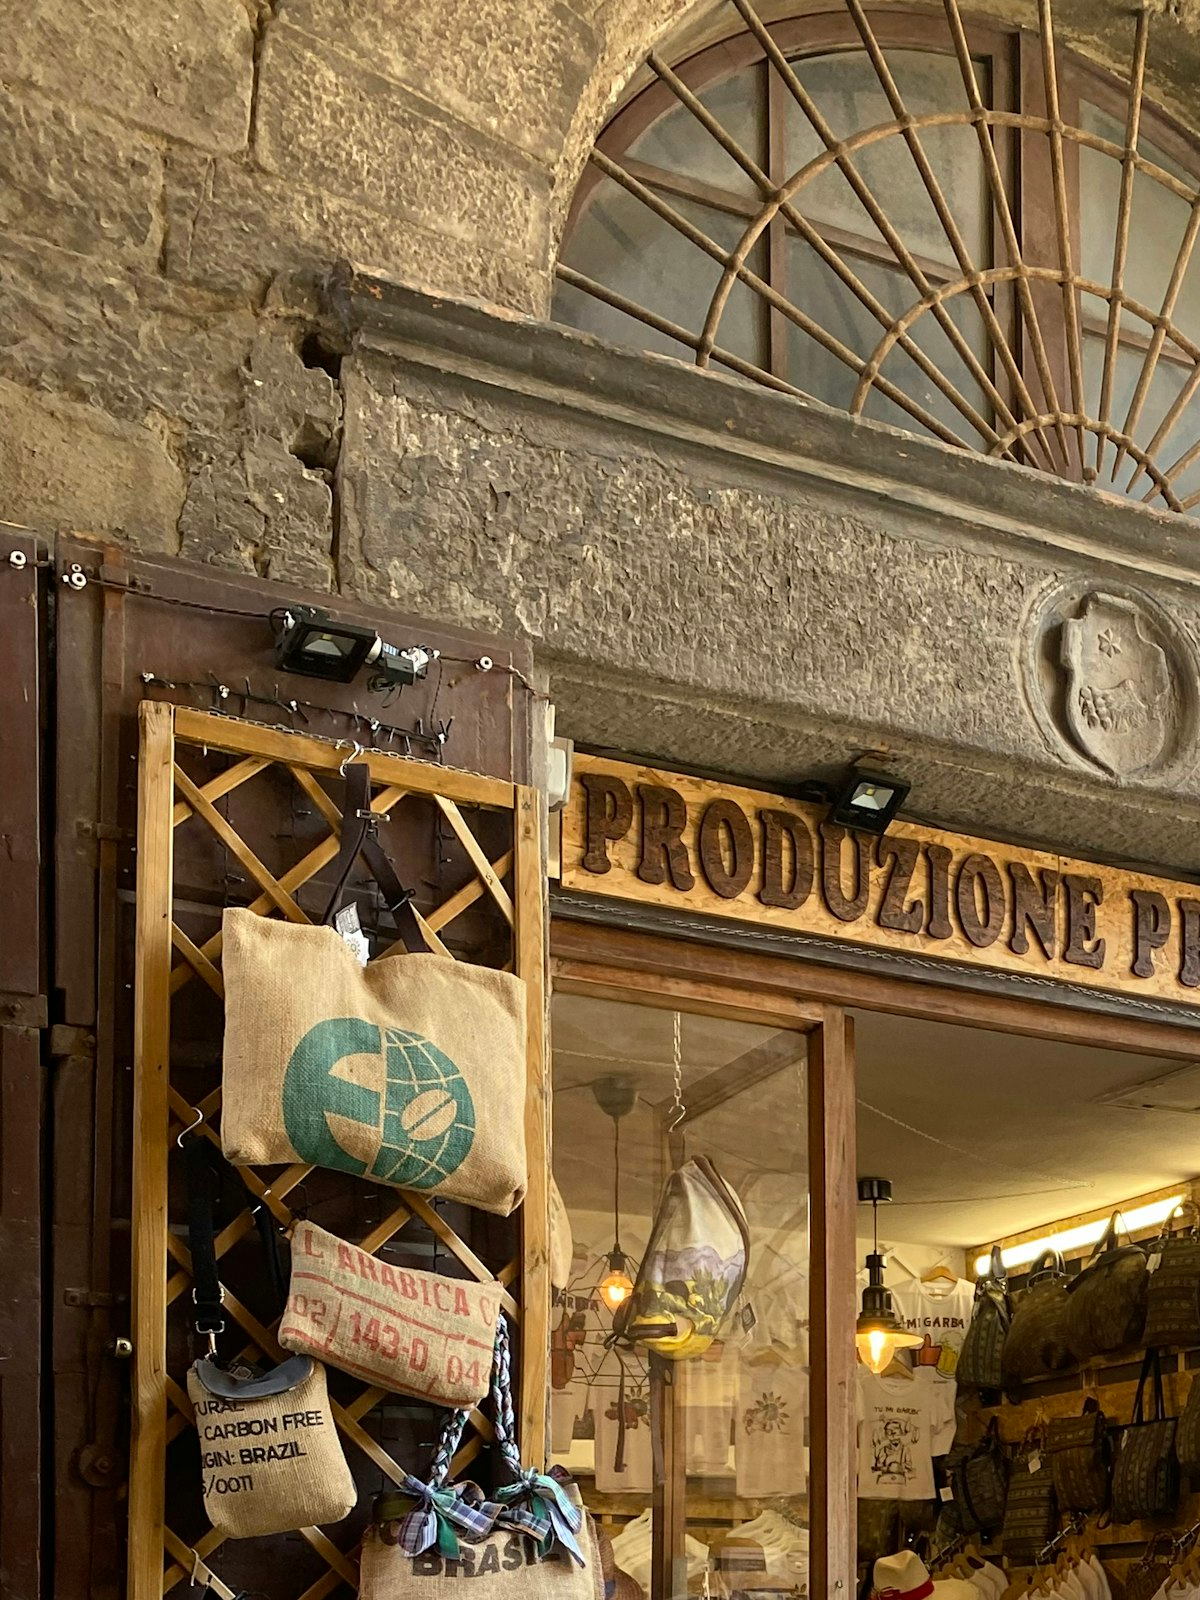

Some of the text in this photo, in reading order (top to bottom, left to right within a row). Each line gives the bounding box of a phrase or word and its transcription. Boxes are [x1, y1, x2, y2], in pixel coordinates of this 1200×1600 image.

[578, 772, 1107, 969] PRODUZIONE
[338, 1243, 470, 1316] ARABICA
[204, 1410, 324, 1441] CARBON FREE
[239, 1441, 307, 1465] BRAZIL
